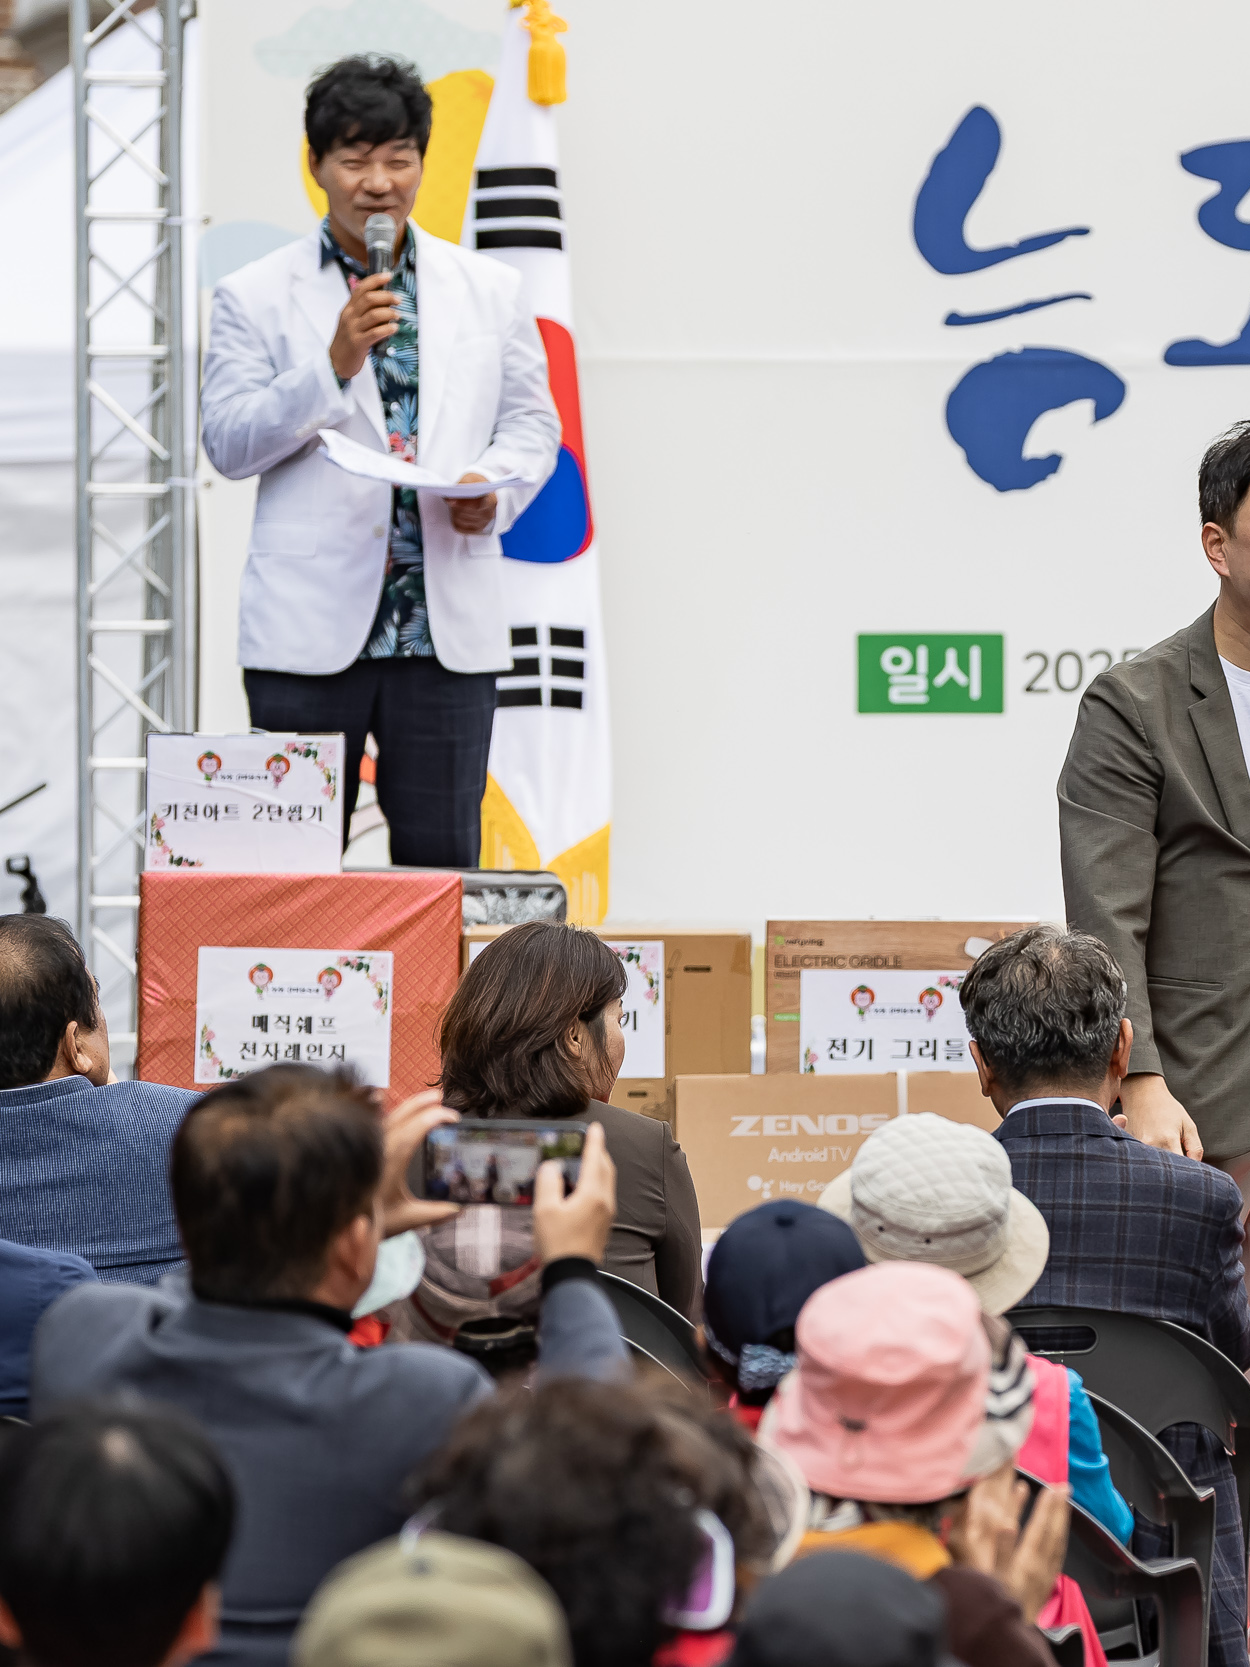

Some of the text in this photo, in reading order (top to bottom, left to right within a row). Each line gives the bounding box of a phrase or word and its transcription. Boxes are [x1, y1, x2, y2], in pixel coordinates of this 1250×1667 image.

[880, 644, 983, 705] 일시
[161, 802, 240, 823] 키친아트
[252, 1014, 337, 1035] 매직쉐프
[239, 1040, 346, 1063] 전자레인지
[827, 1037, 874, 1062] 전기
[767, 1146, 829, 1163] Android
